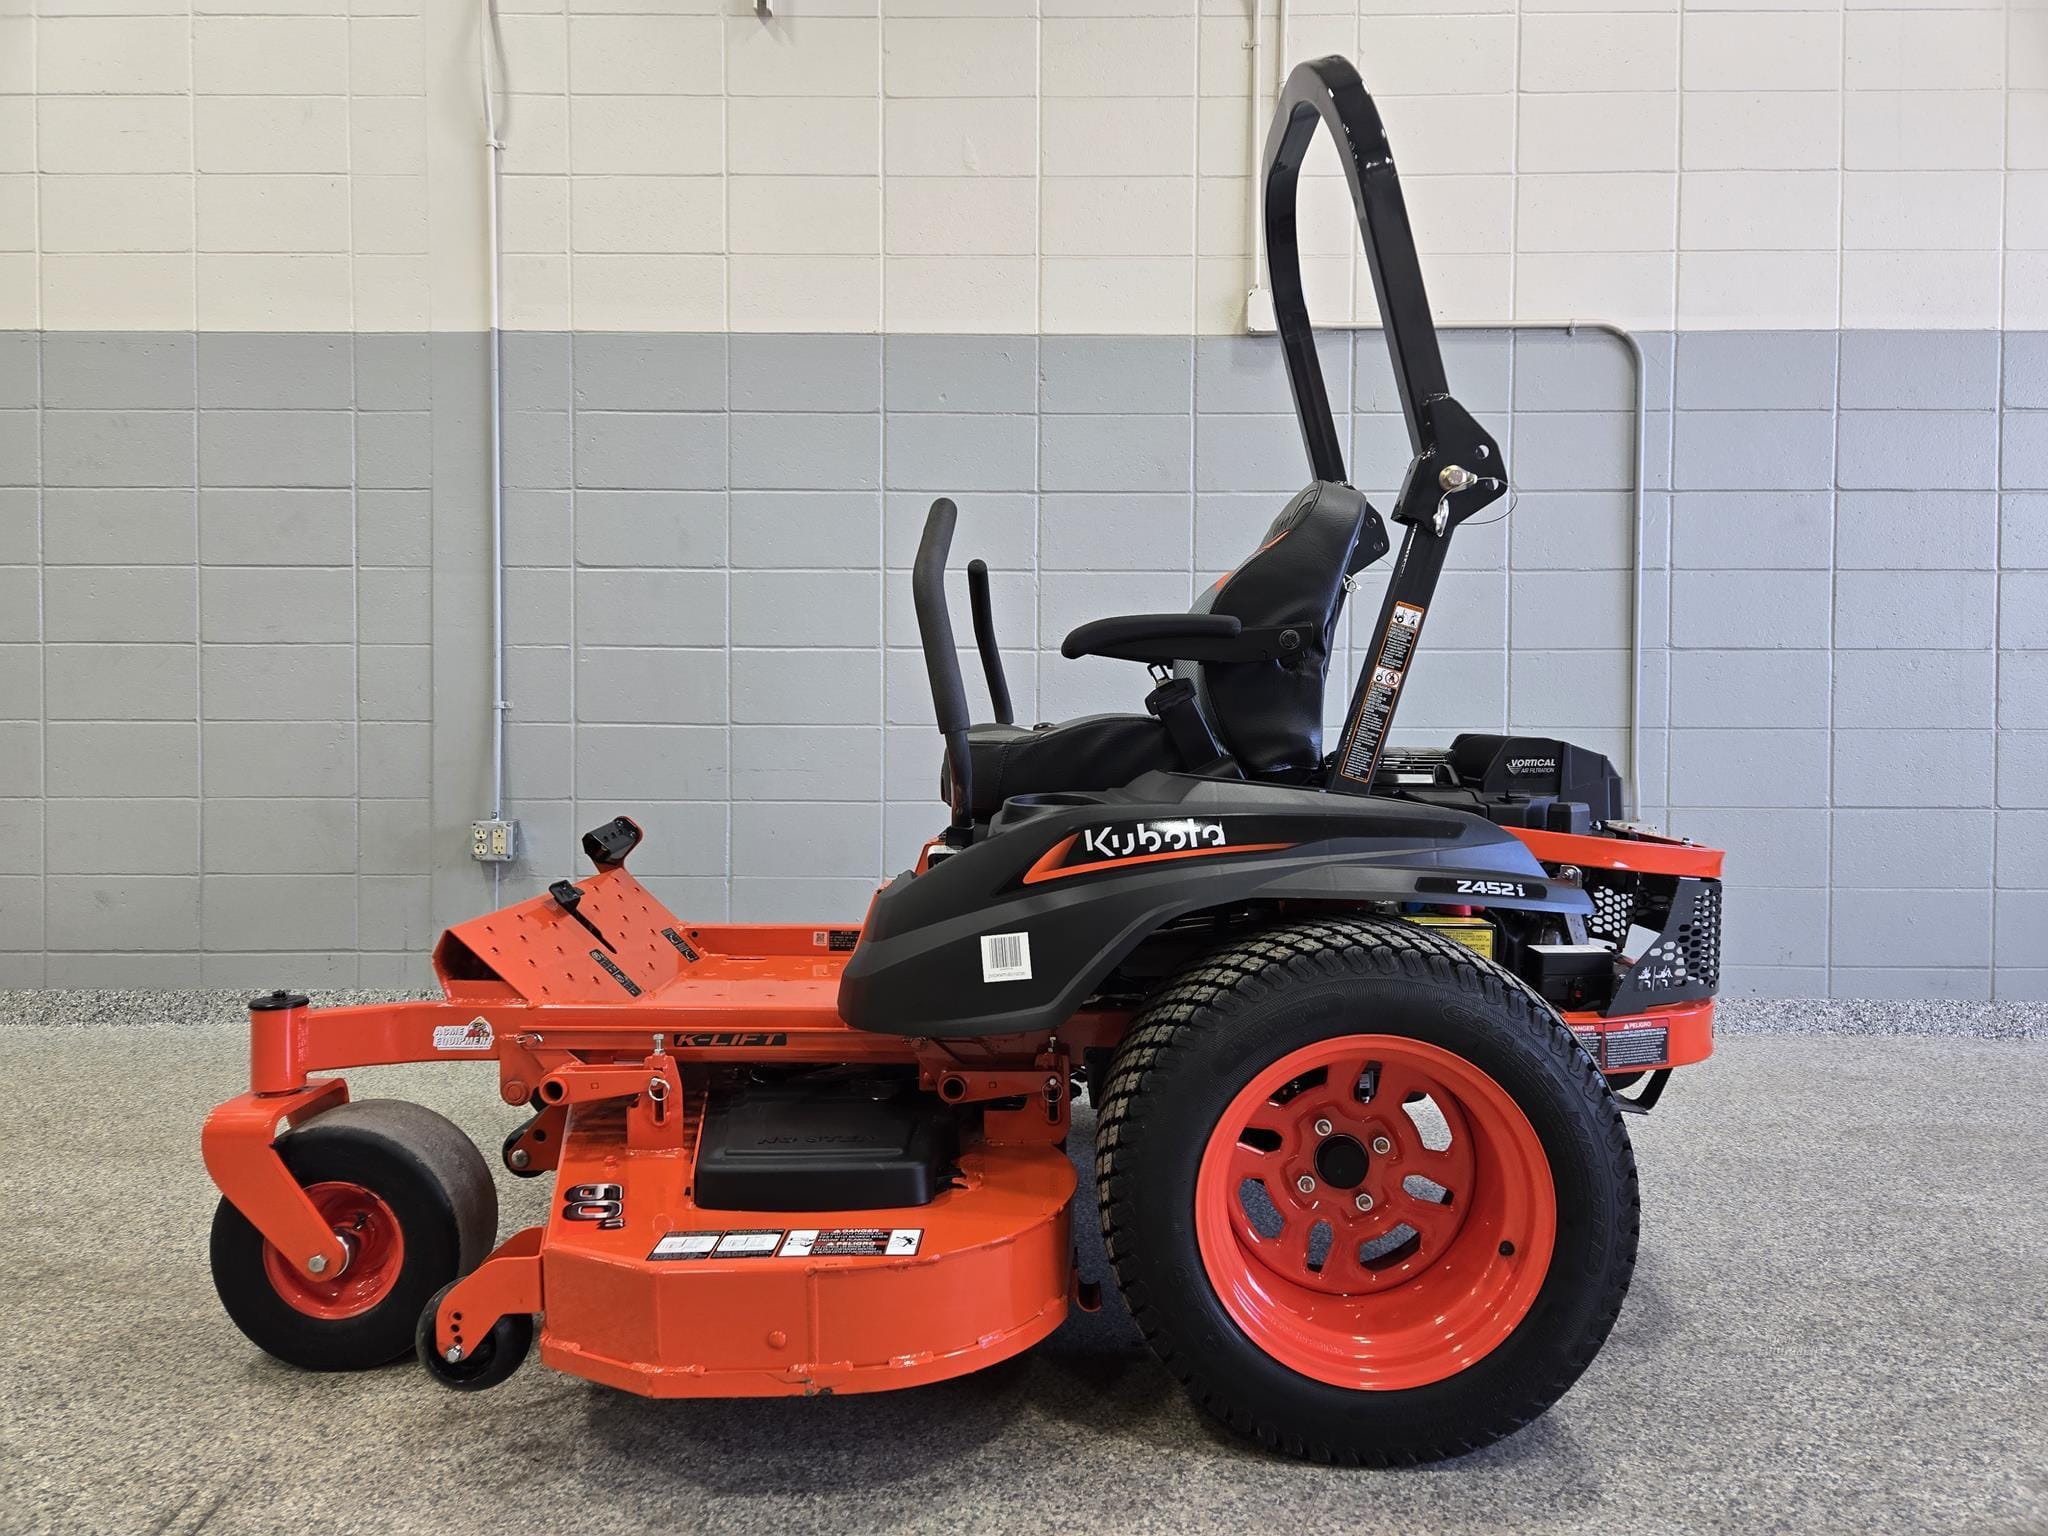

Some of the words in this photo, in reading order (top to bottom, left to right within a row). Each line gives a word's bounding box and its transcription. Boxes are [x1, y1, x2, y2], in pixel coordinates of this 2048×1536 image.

[1511, 758, 1556, 767] VORTICAL
[1083, 818, 1226, 857] Kubota
[1456, 879, 1526, 897] Z452i
[1629, 1021, 1652, 1029] PELIGRO
[435, 1027, 465, 1036] ACME
[435, 1036, 494, 1046] EQUIPMENT
[676, 1033, 784, 1046] K-LIFT
